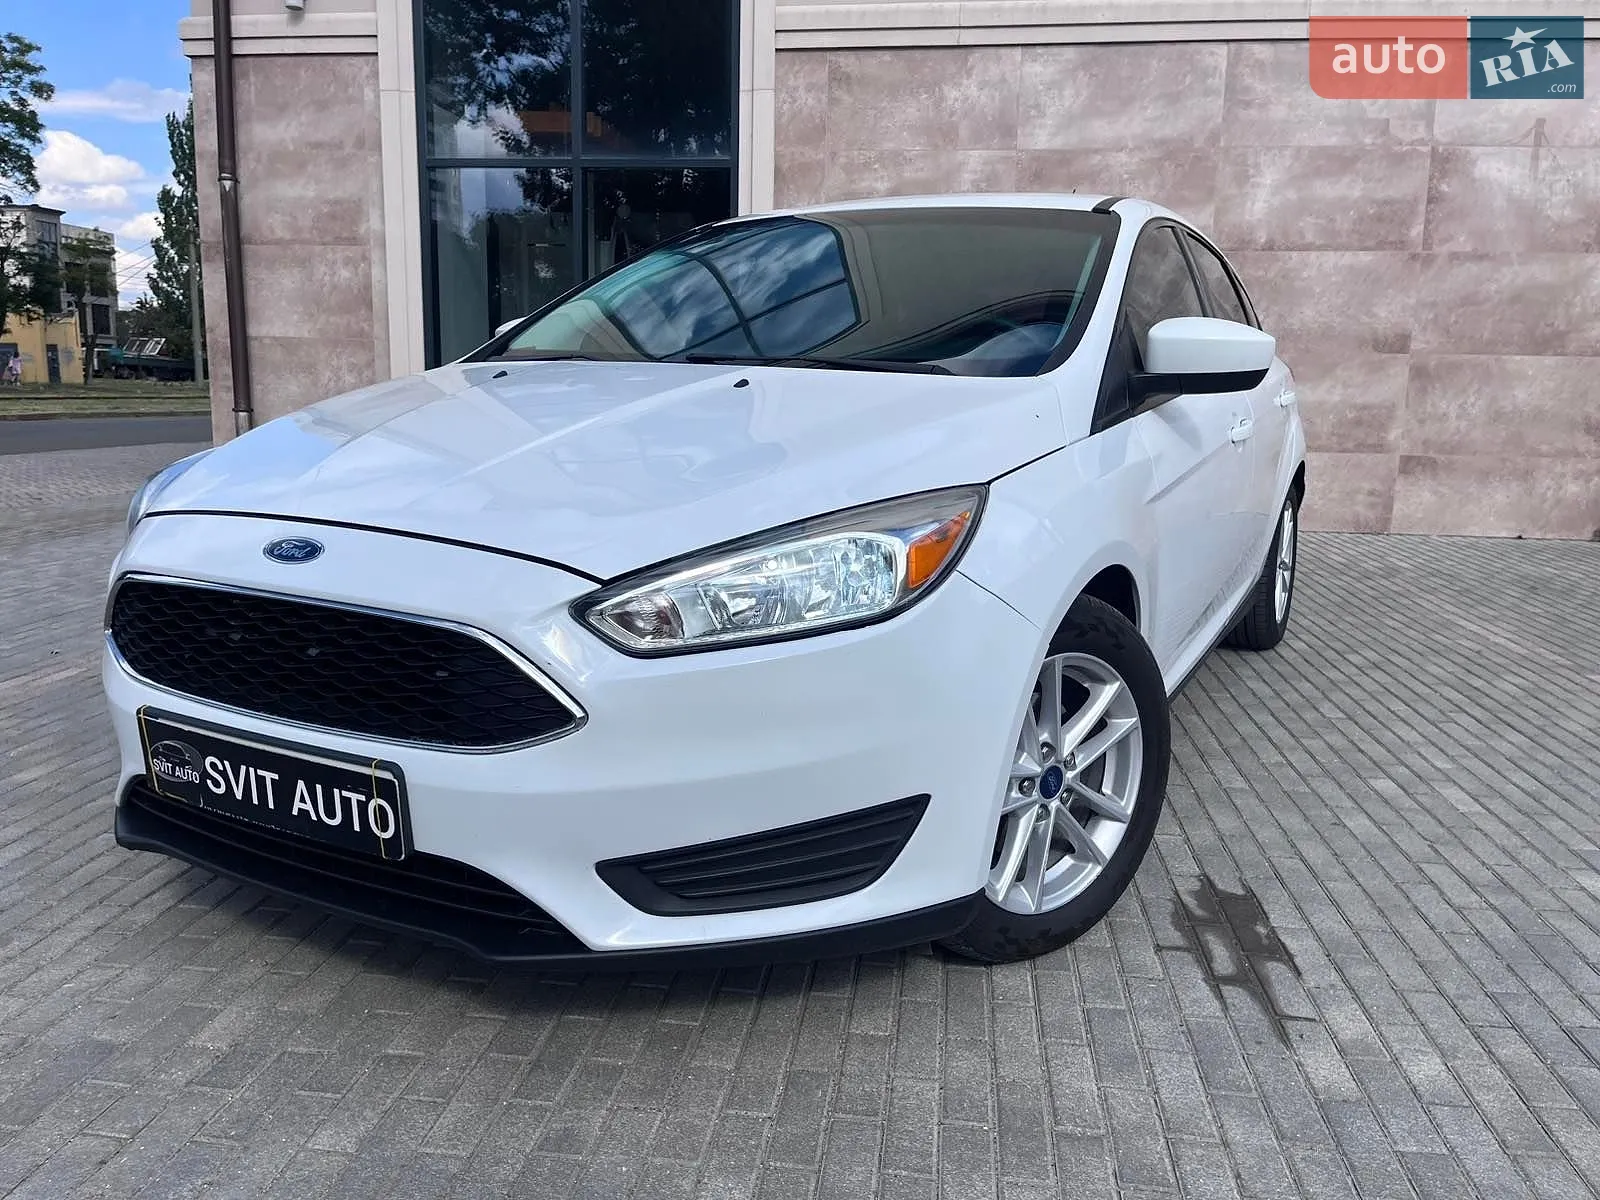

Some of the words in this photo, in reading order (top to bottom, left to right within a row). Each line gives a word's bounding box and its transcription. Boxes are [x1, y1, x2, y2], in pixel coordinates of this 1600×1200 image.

[273, 540, 311, 558] Ford
[153, 758, 173, 775] SVIT
[174, 765, 200, 784] AUTO
[204, 755, 279, 810] SVIT
[291, 779, 396, 840] AUTO
